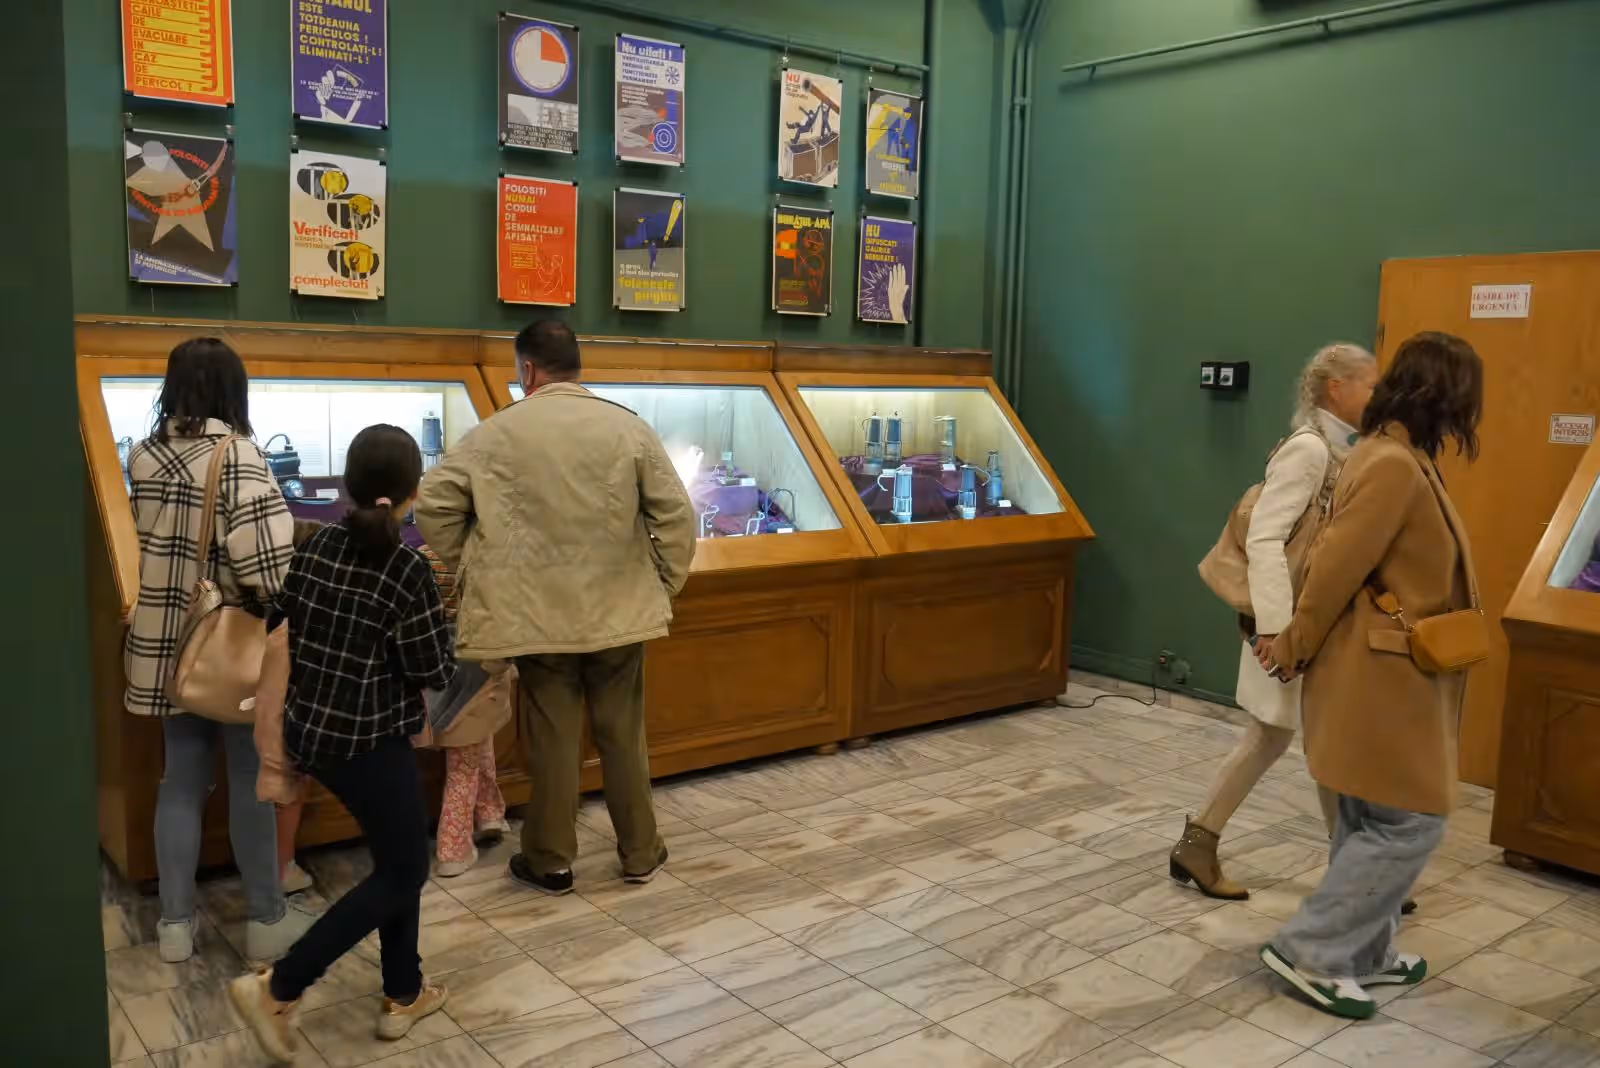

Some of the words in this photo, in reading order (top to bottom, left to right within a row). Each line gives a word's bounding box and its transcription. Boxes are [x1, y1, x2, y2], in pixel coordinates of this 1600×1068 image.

[299, 2, 323, 14] ESTE
[133, 15, 145, 26] DE
[299, 13, 360, 32] TOTDEAUNA
[133, 28, 188, 44] EVACUARE
[299, 23, 360, 42] PERICULOS
[622, 41, 636, 54] Nu
[134, 53, 156, 63] CAZ
[135, 64, 148, 74] DE
[136, 77, 181, 91] PERICOL
[785, 73, 800, 83] NU
[505, 184, 547, 196] FOLOSITI
[505, 193, 536, 204] NUMAI
[505, 203, 538, 214] CODUL
[505, 213, 517, 222] DE
[293, 221, 359, 241] Verificati
[504, 222, 564, 236] SEMNALIZARE
[866, 224, 880, 237] NU
[294, 275, 369, 290] complectati
